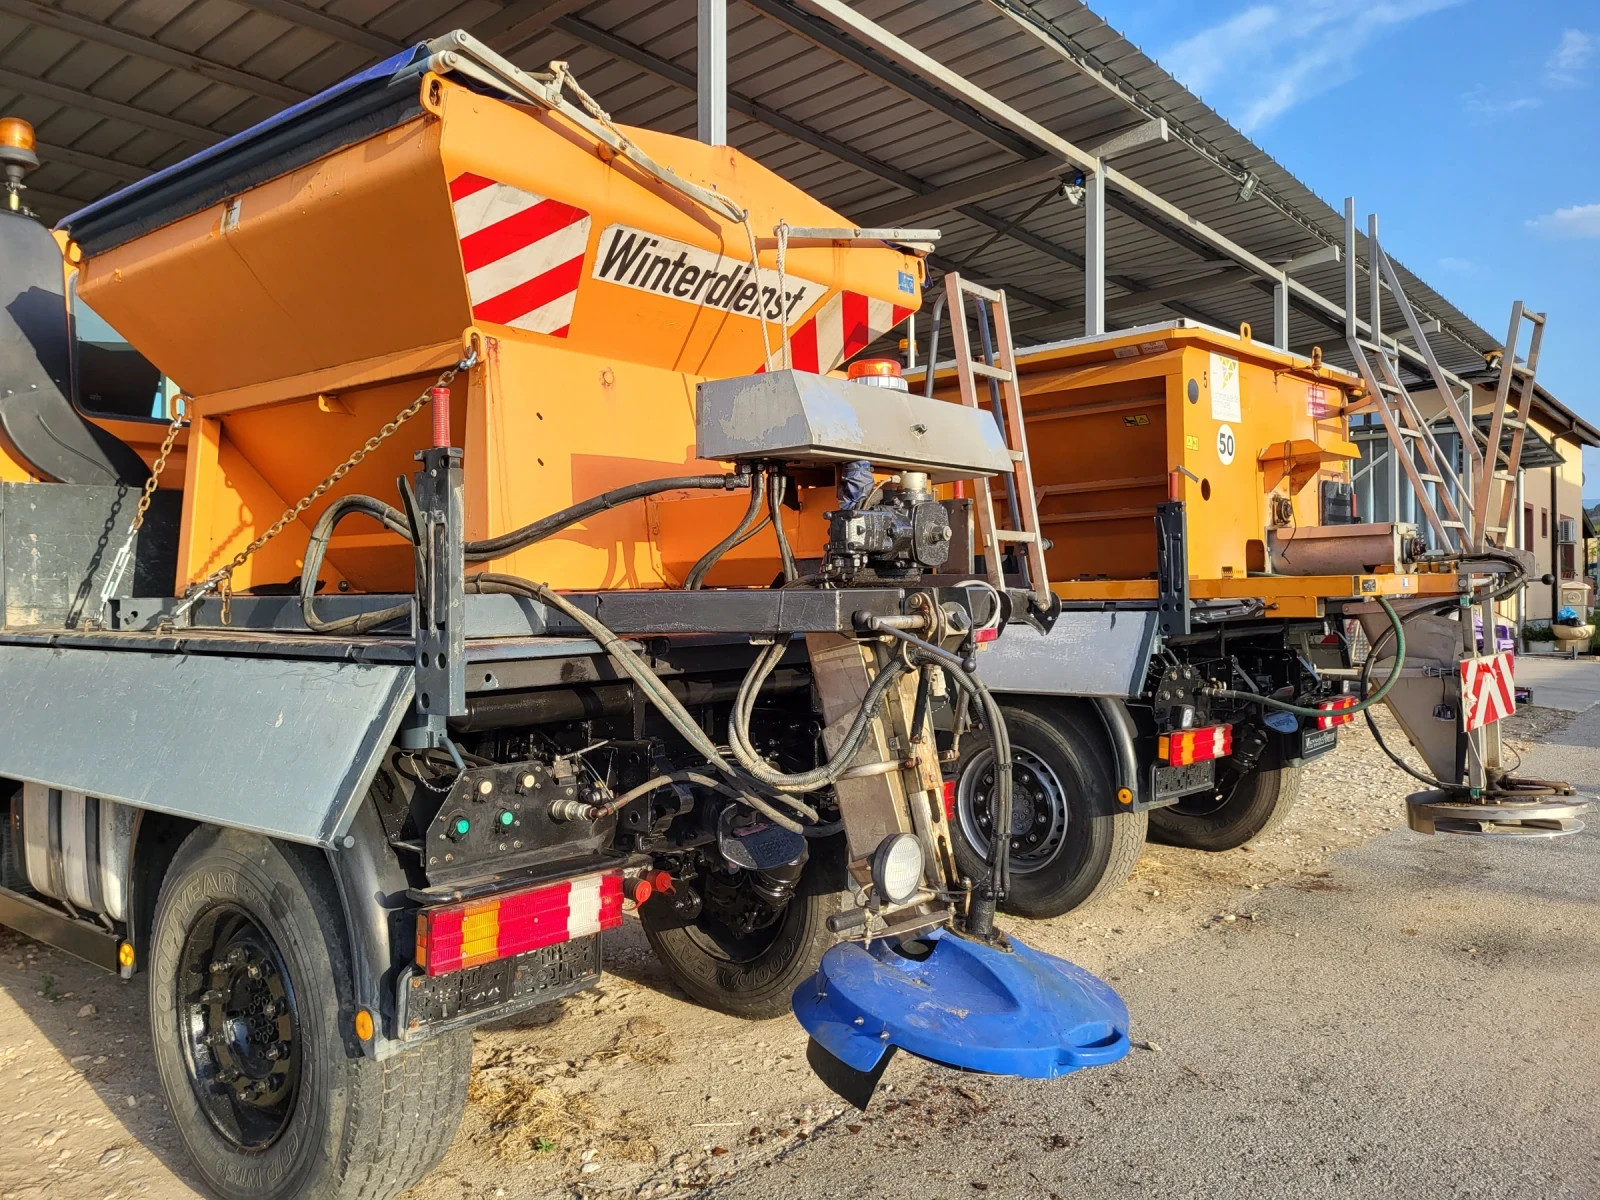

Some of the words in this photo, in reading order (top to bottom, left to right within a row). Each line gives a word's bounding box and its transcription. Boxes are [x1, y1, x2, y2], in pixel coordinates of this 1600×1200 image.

[598, 228, 807, 322] Winterdienst
[1218, 432, 1235, 457] 50
[156, 871, 236, 1043] GOODYEAR
